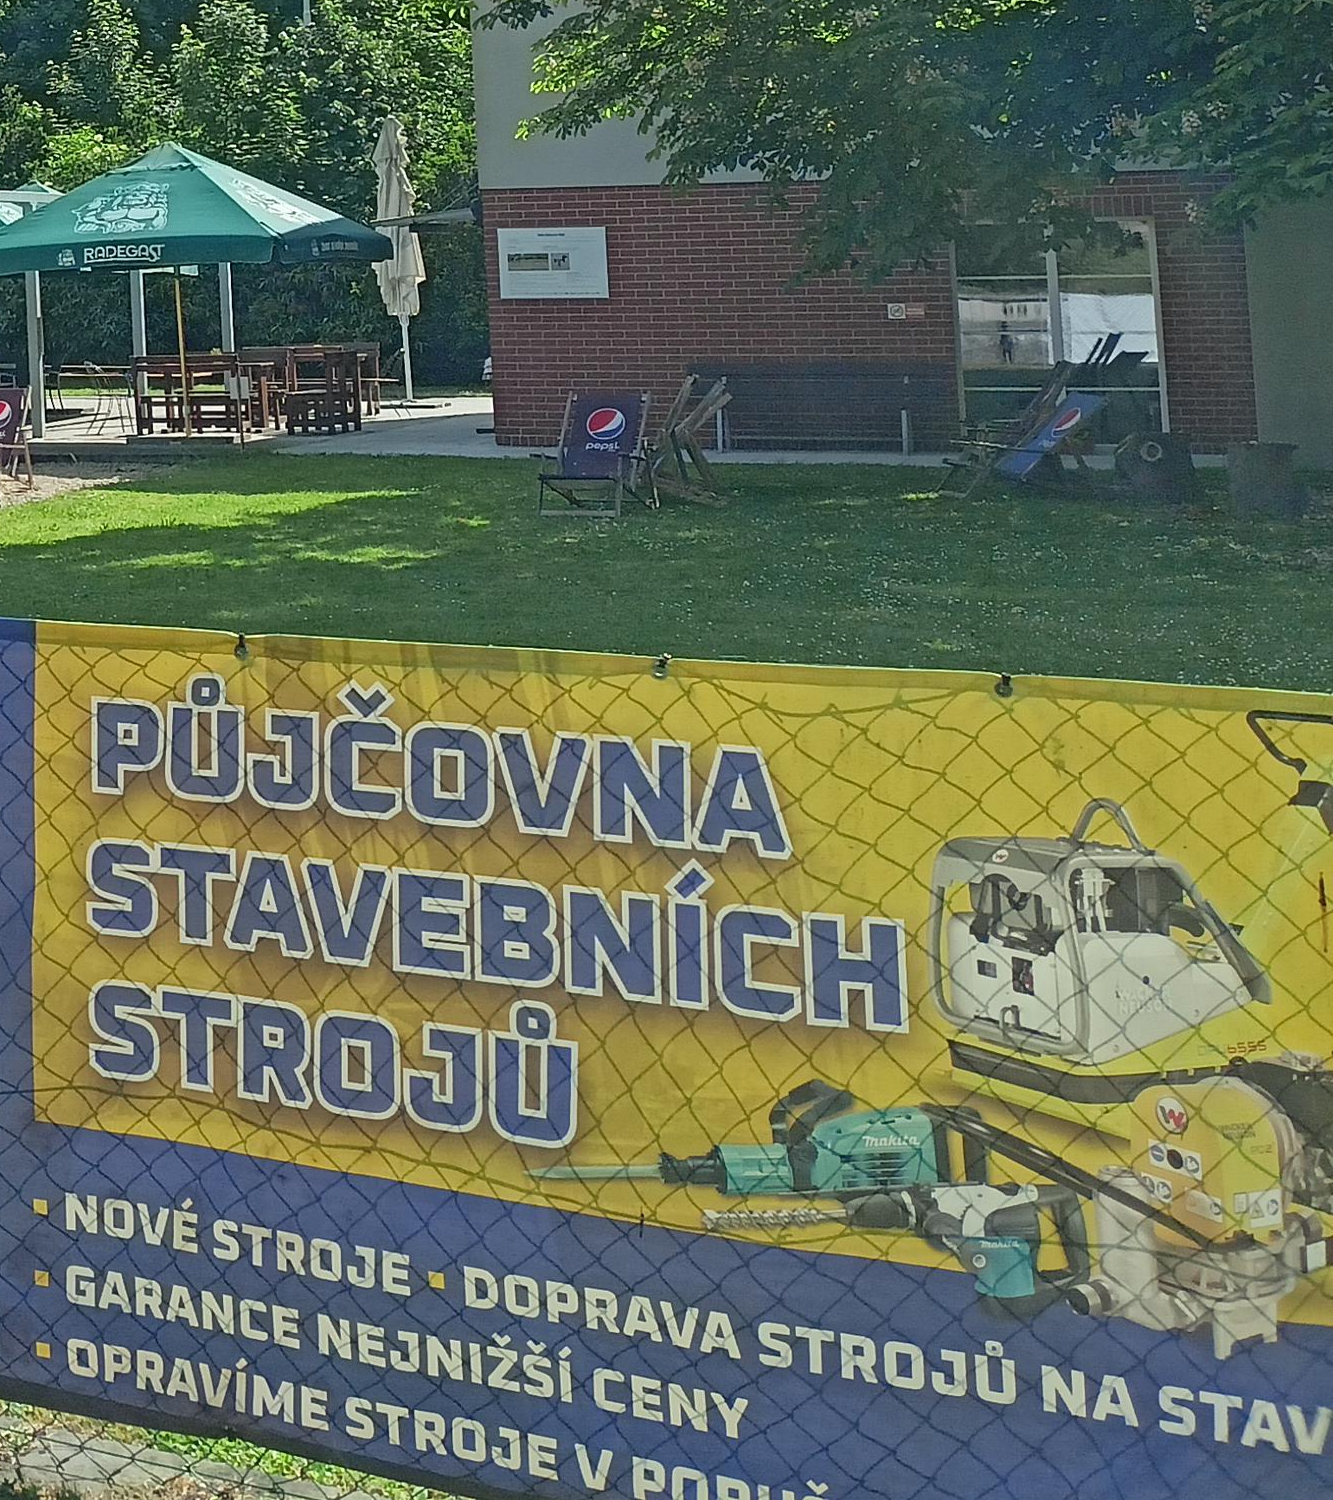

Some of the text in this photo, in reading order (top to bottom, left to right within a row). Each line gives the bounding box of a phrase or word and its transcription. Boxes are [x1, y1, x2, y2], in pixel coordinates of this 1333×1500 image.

[84, 244, 165, 263] RADEGAST
[89, 672, 793, 860] PŮJČOVNA
[85, 838, 910, 1034] STAVEBNÍCH
[88, 981, 578, 1148] STROJŮ
[65, 1192, 1333, 1456] NOVÉ STROJE DOPRAVA STROJŮ NA STAV
[66, 1265, 748, 1439] GARANCE NEJNIŽŠÍ CENY
[68, 1338, 330, 1432] OPRAVÍME
[345, 1396, 559, 1481] STROJE
[574, 1442, 613, 1491] V
